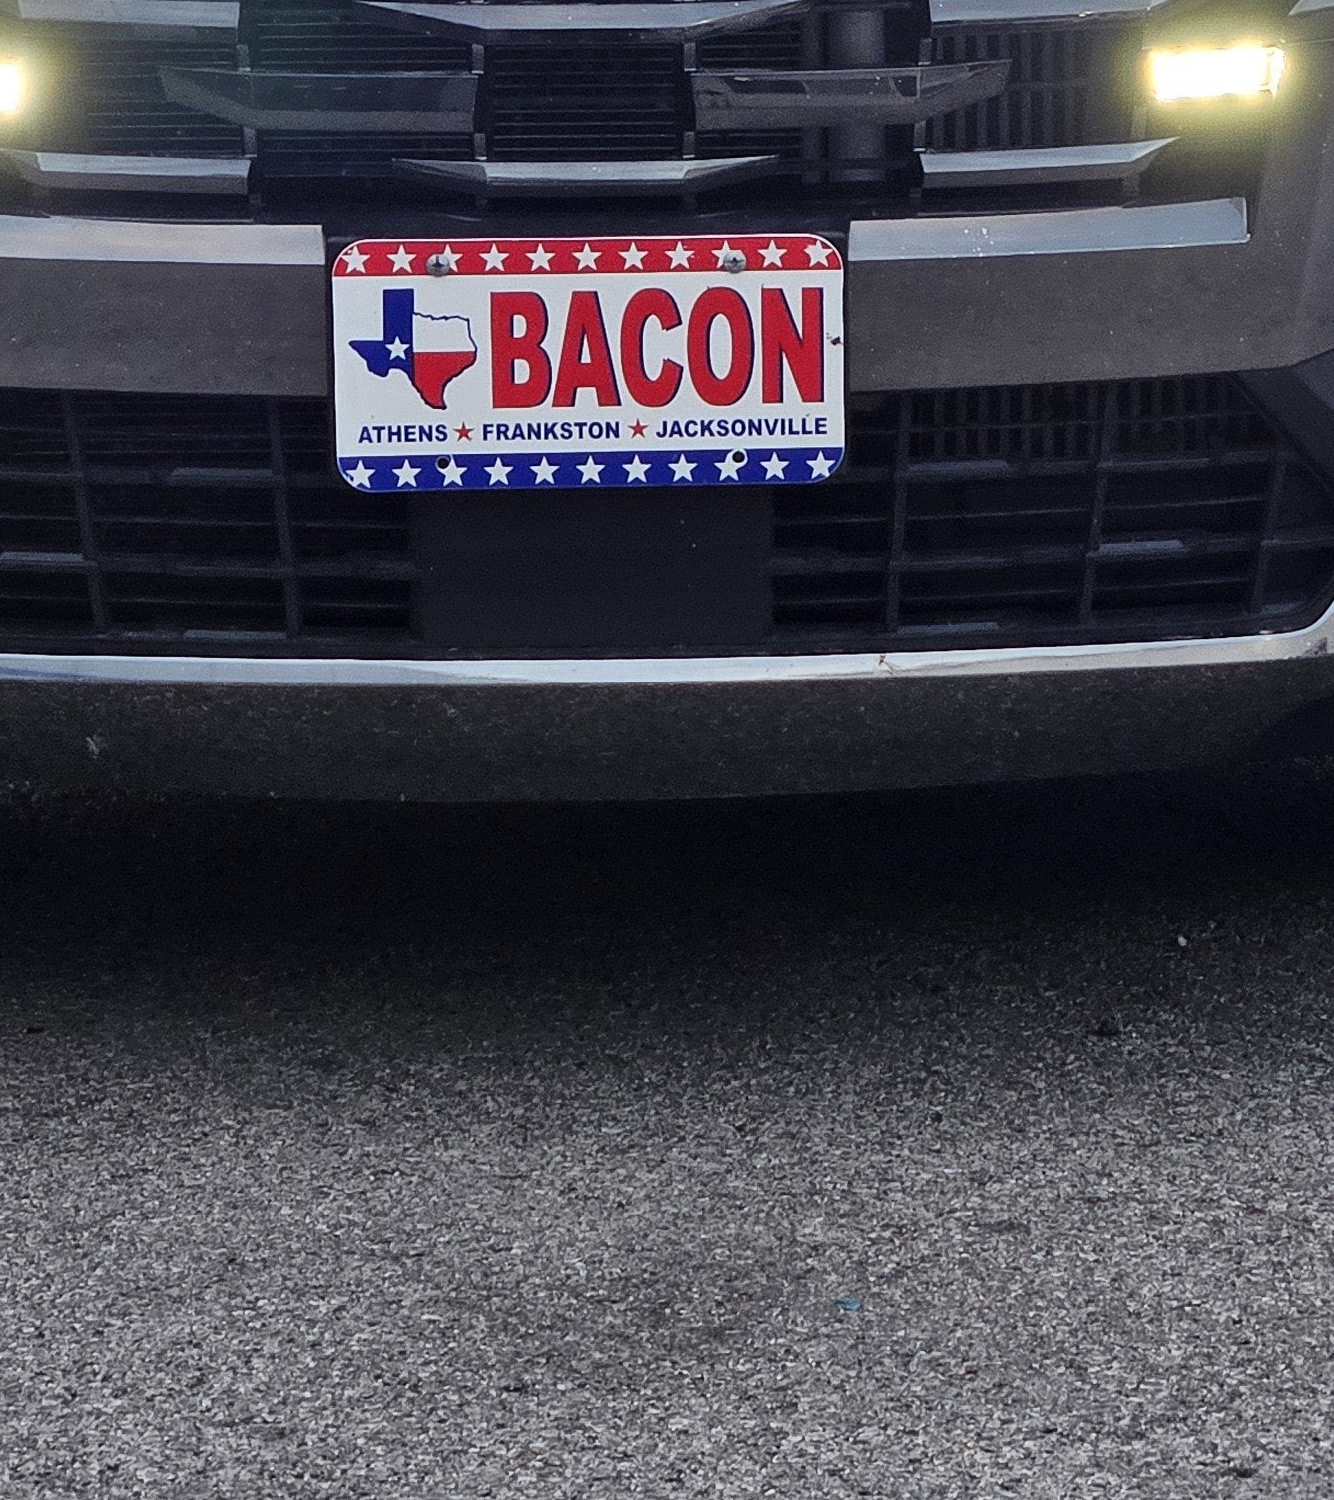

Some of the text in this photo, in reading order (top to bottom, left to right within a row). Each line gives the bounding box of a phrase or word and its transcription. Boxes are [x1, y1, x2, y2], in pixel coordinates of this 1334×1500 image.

[490, 286, 825, 409] BACON
[358, 418, 828, 444] ATHENS FRANKSTON JACKSONVILLE
